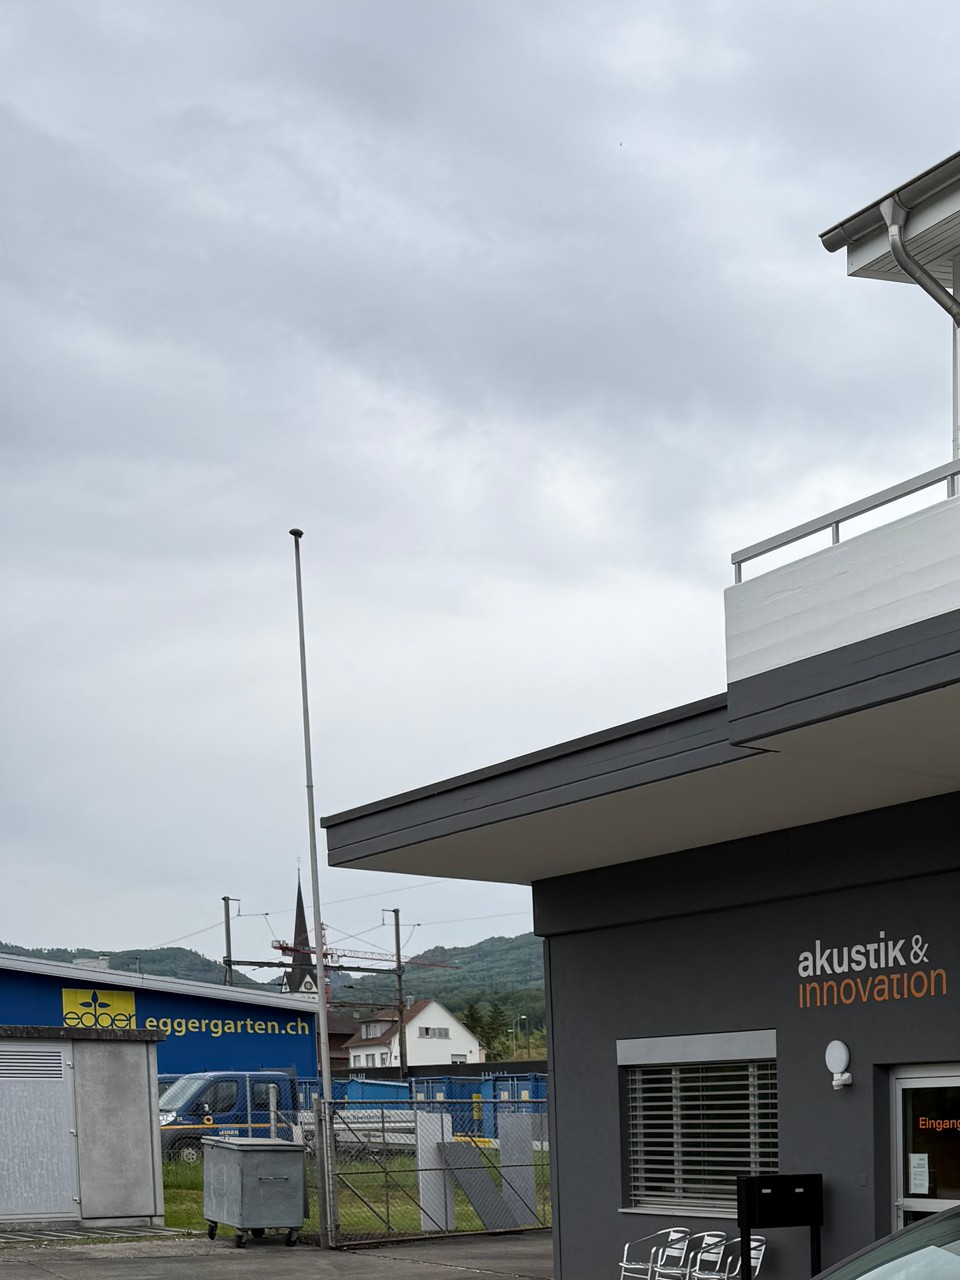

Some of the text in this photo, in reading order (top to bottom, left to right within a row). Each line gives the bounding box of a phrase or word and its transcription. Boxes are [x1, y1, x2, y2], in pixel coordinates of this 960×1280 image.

[798, 931, 929, 978] akustik &
[798, 968, 947, 1009] innovation
[145, 1016, 310, 1038] eggergarten.ch
